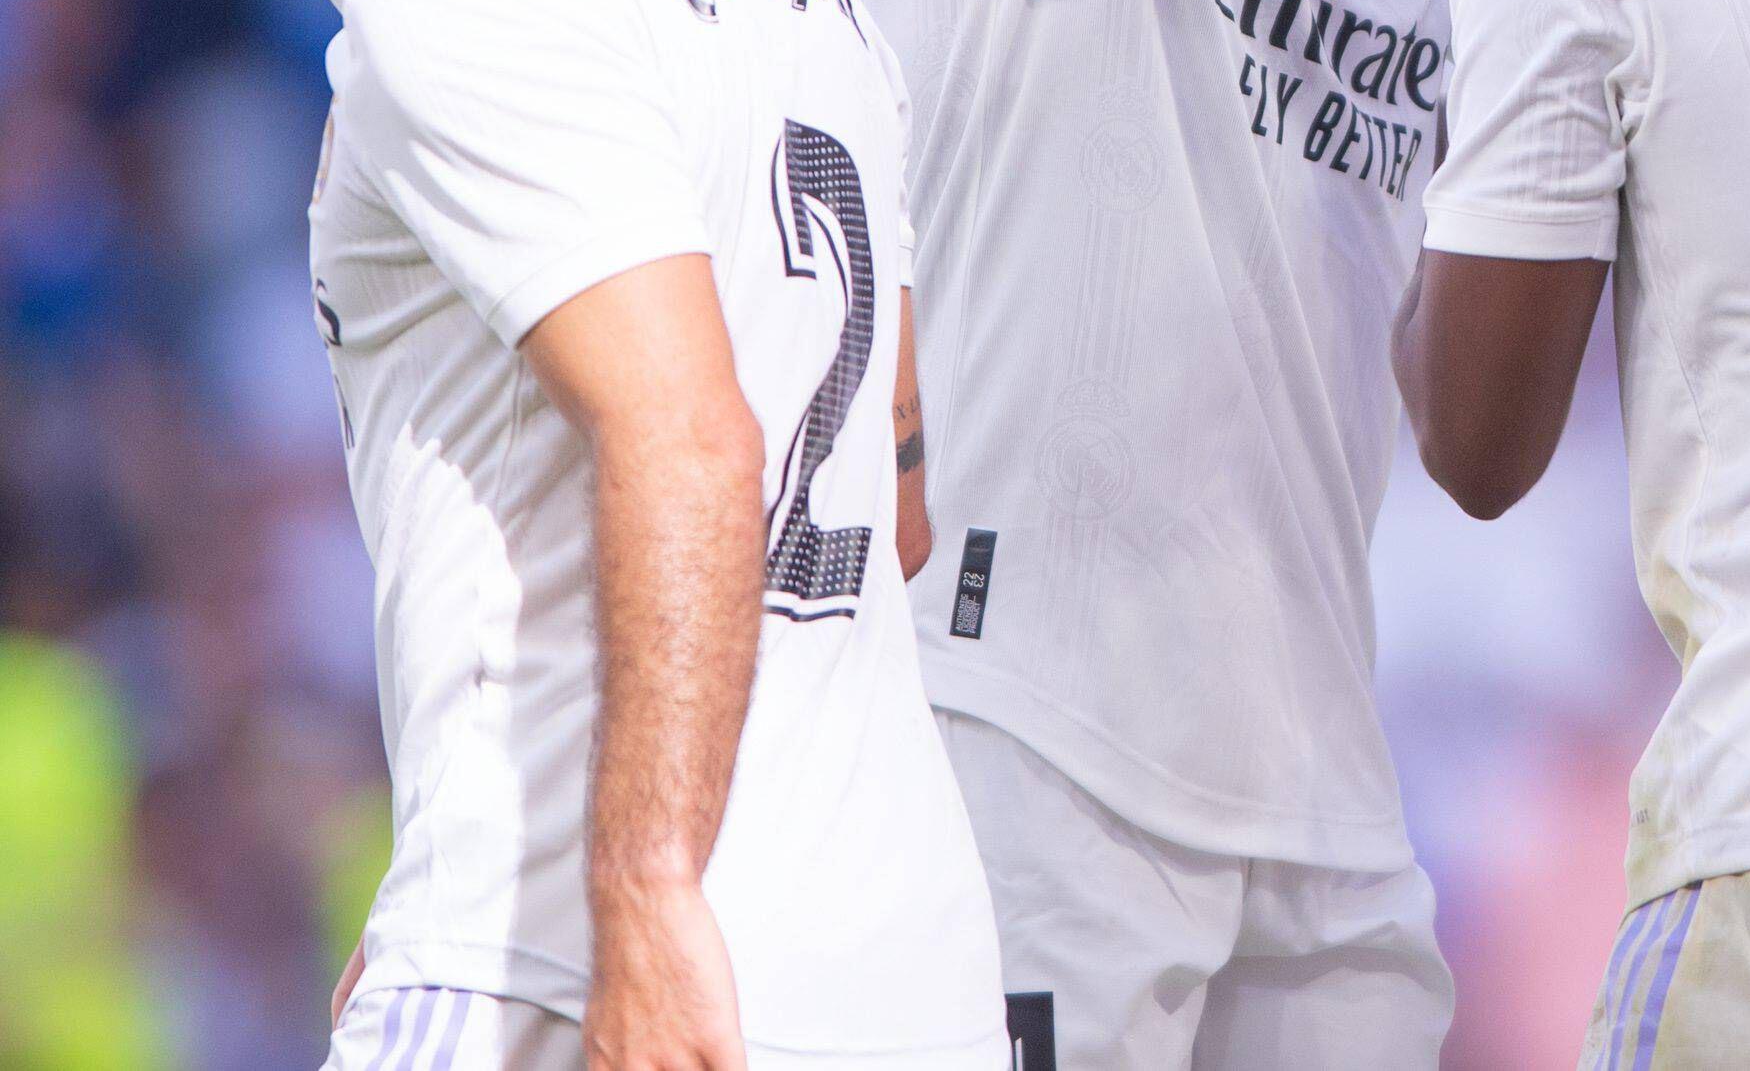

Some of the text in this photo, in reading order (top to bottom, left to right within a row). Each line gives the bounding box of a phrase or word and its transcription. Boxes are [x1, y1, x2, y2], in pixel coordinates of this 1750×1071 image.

[1239, 52, 1423, 202] FLY BETTER
[763, 118, 874, 622] 2
[963, 571, 975, 587] 22
